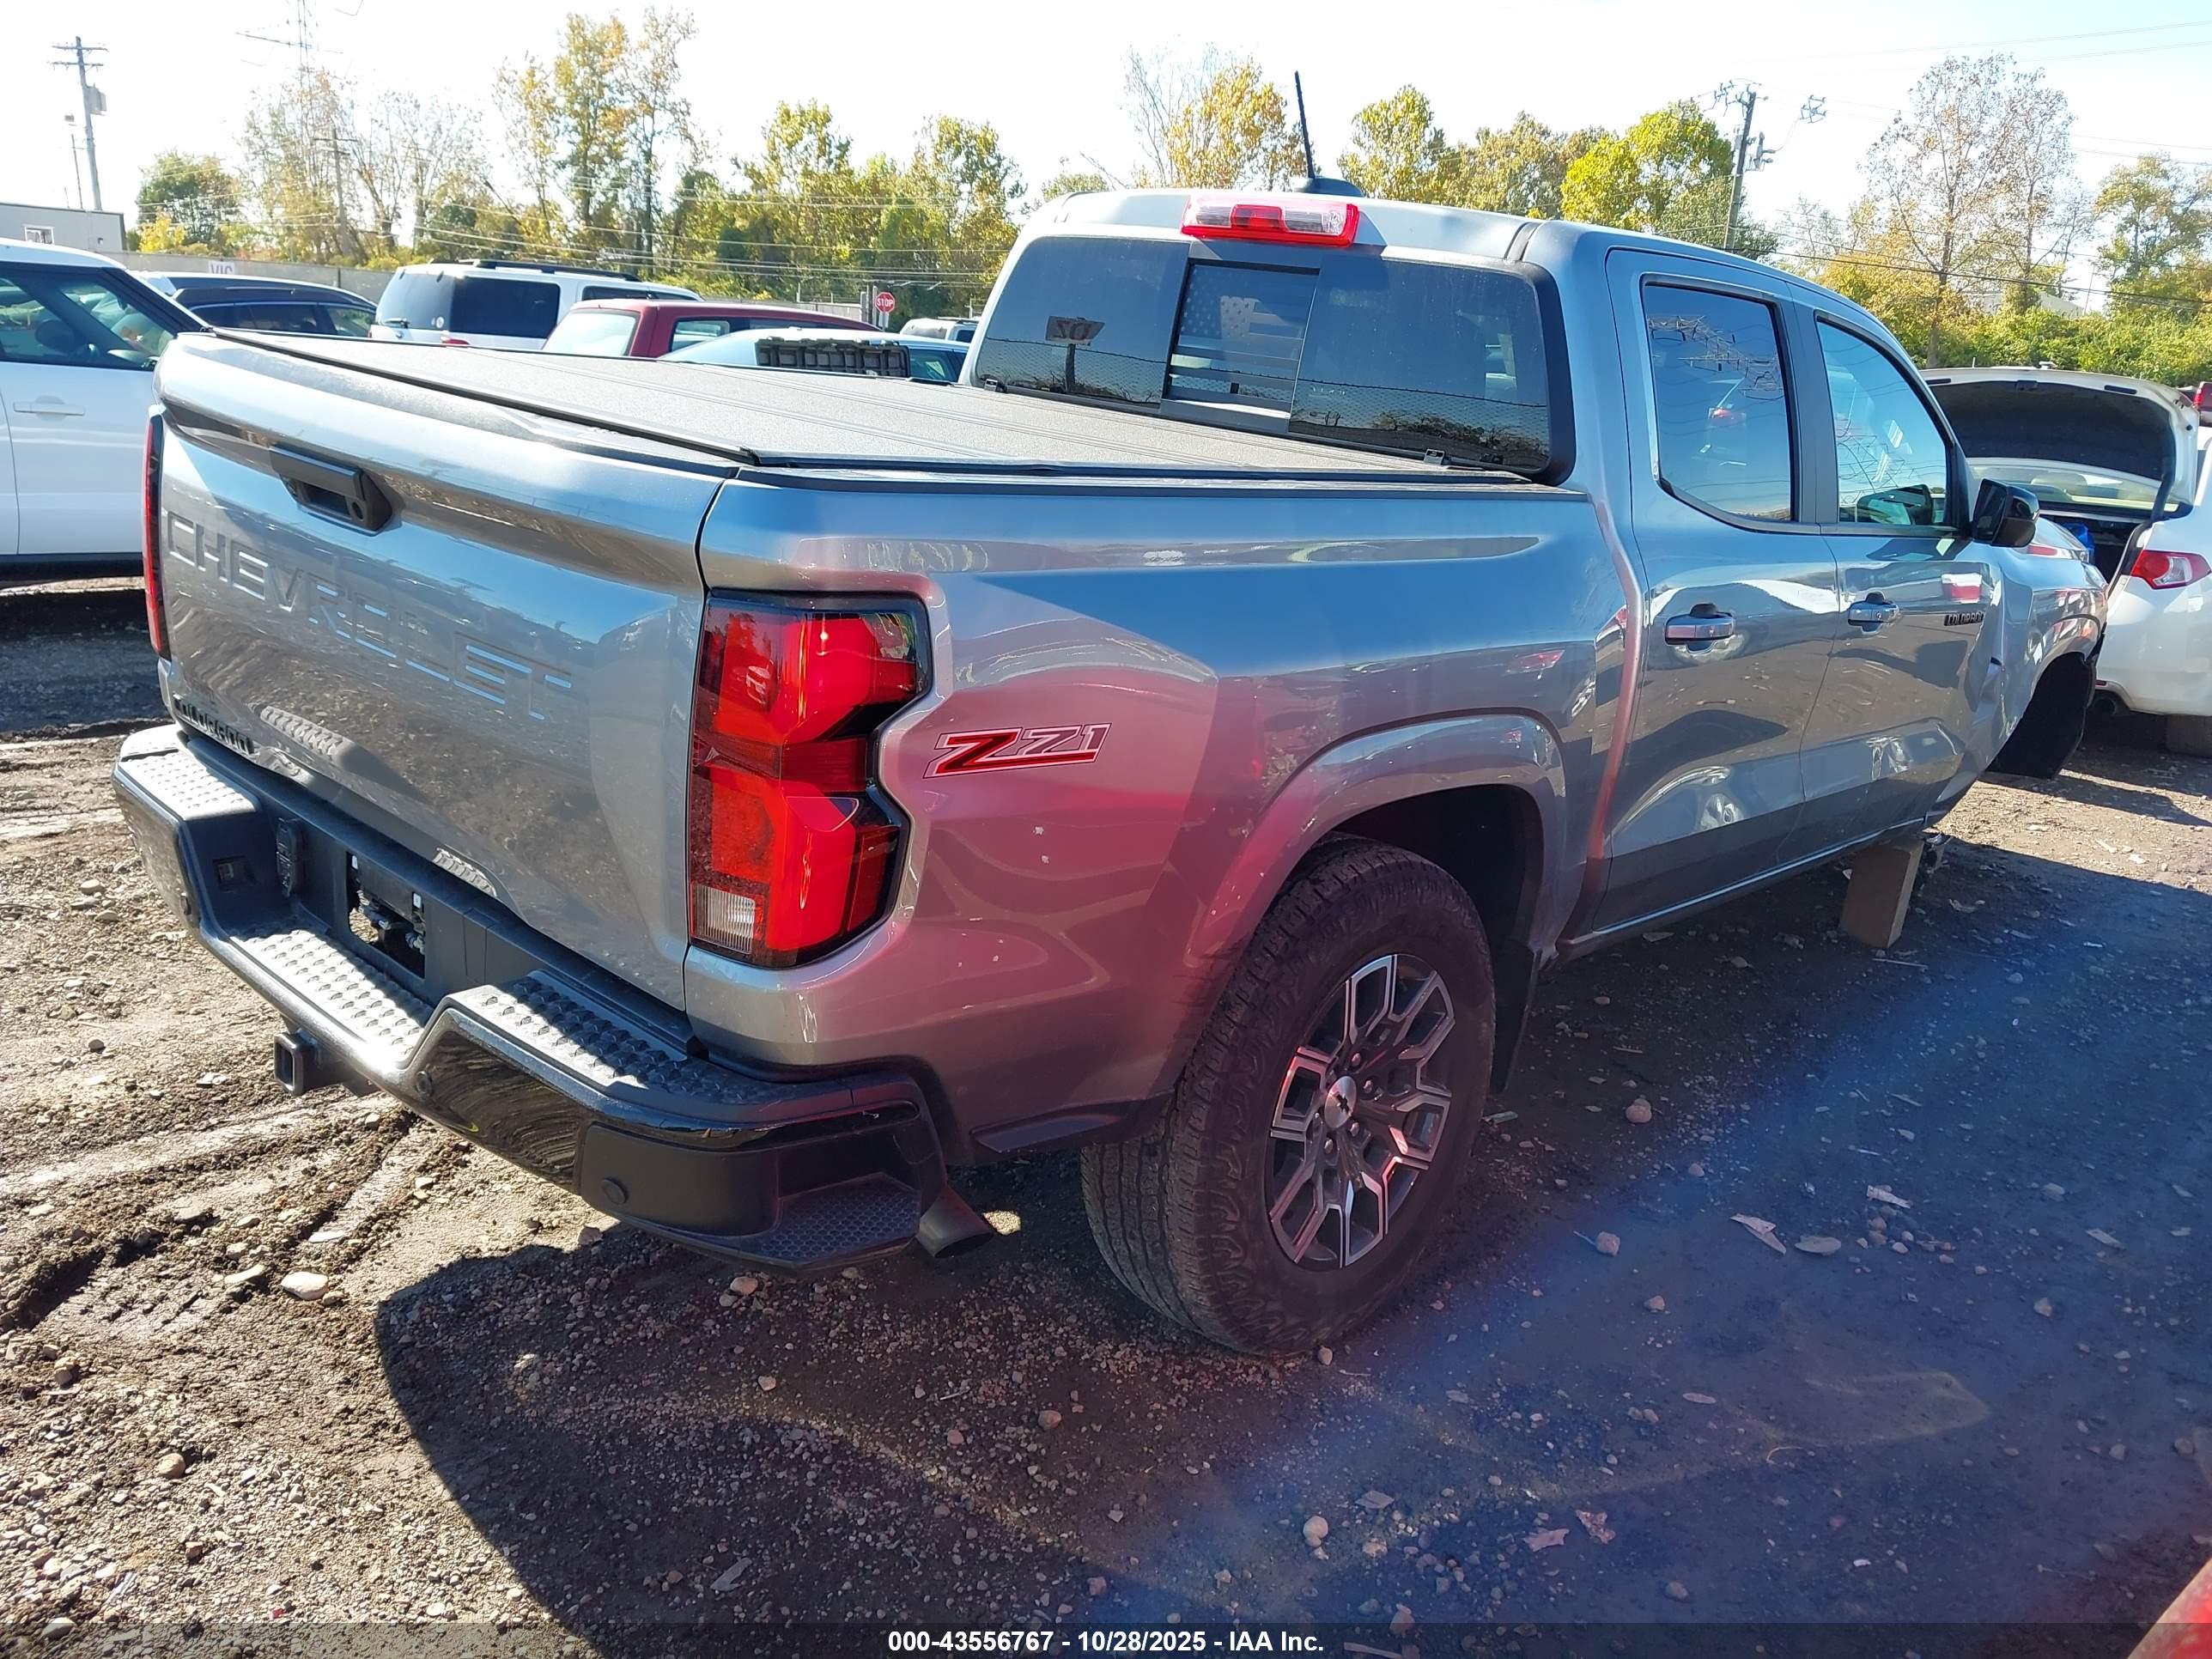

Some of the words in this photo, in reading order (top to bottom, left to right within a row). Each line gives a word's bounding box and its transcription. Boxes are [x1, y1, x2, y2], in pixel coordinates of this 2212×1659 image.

[877, 298, 893, 307] STOP
[167, 511, 573, 720] CHEVROLET
[922, 722, 1113, 779] Z71
